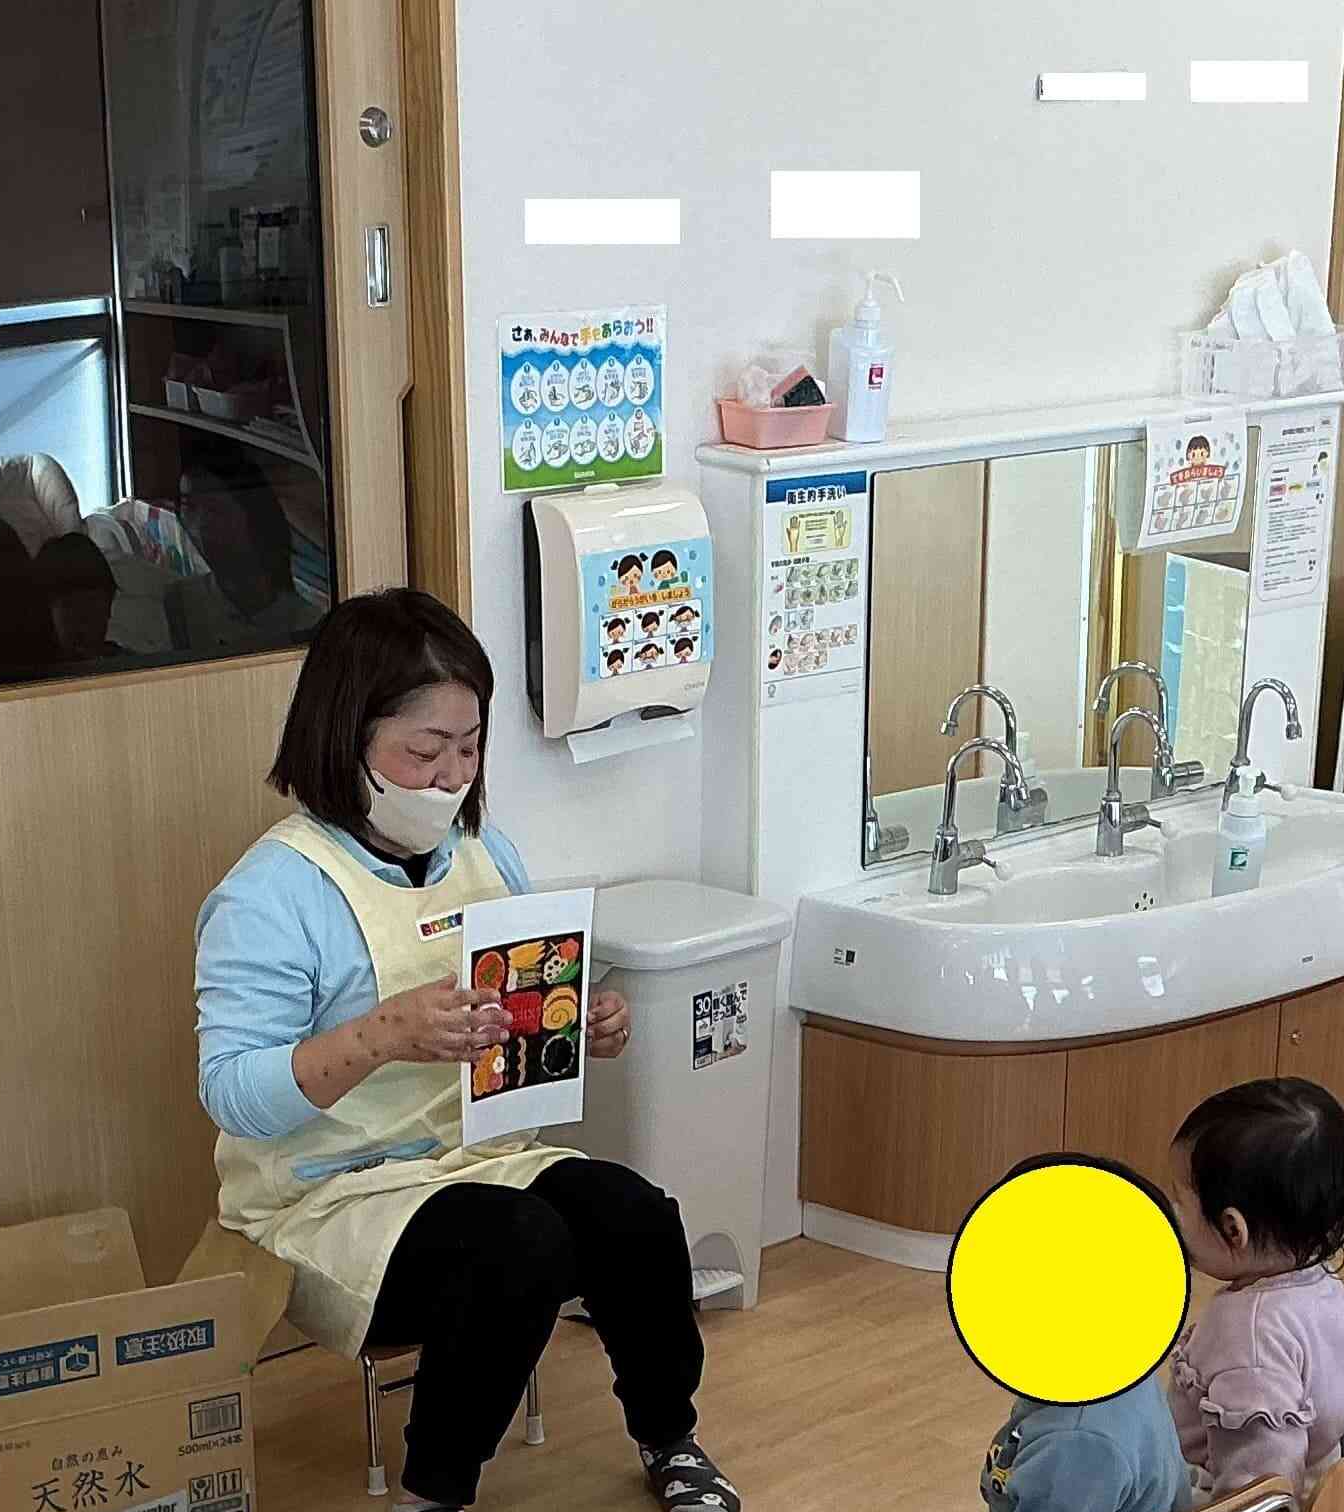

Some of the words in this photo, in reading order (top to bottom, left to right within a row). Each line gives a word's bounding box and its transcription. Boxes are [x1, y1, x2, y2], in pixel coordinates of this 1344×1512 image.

[787, 488, 846, 505] 衛生的手洗い
[696, 998, 711, 1016] 30
[124, 1326, 207, 1360] 取扱注意
